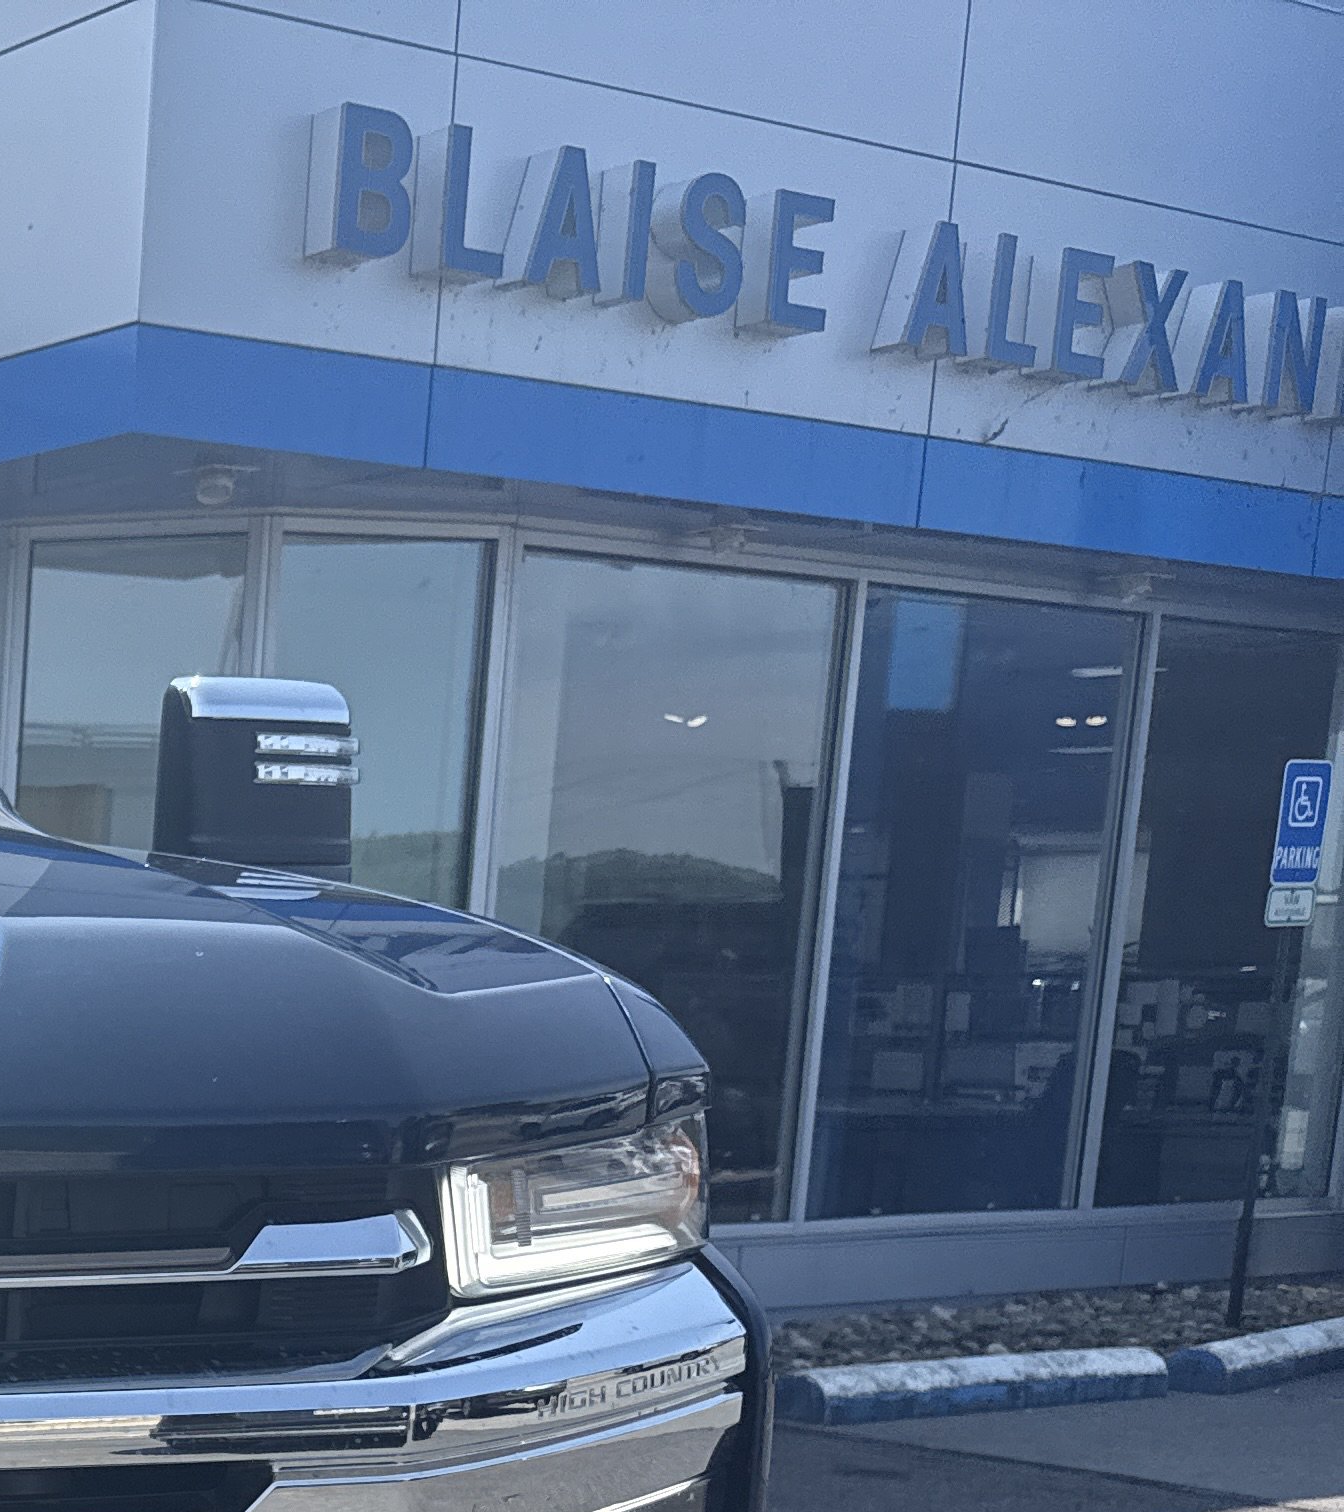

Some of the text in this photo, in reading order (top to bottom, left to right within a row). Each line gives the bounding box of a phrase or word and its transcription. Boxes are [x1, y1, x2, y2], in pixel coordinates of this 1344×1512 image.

[330, 99, 1344, 414] BLAISE ALEXAN
[1273, 846, 1320, 870] PARKING
[536, 1356, 721, 1420] HIGH COUNTRY
